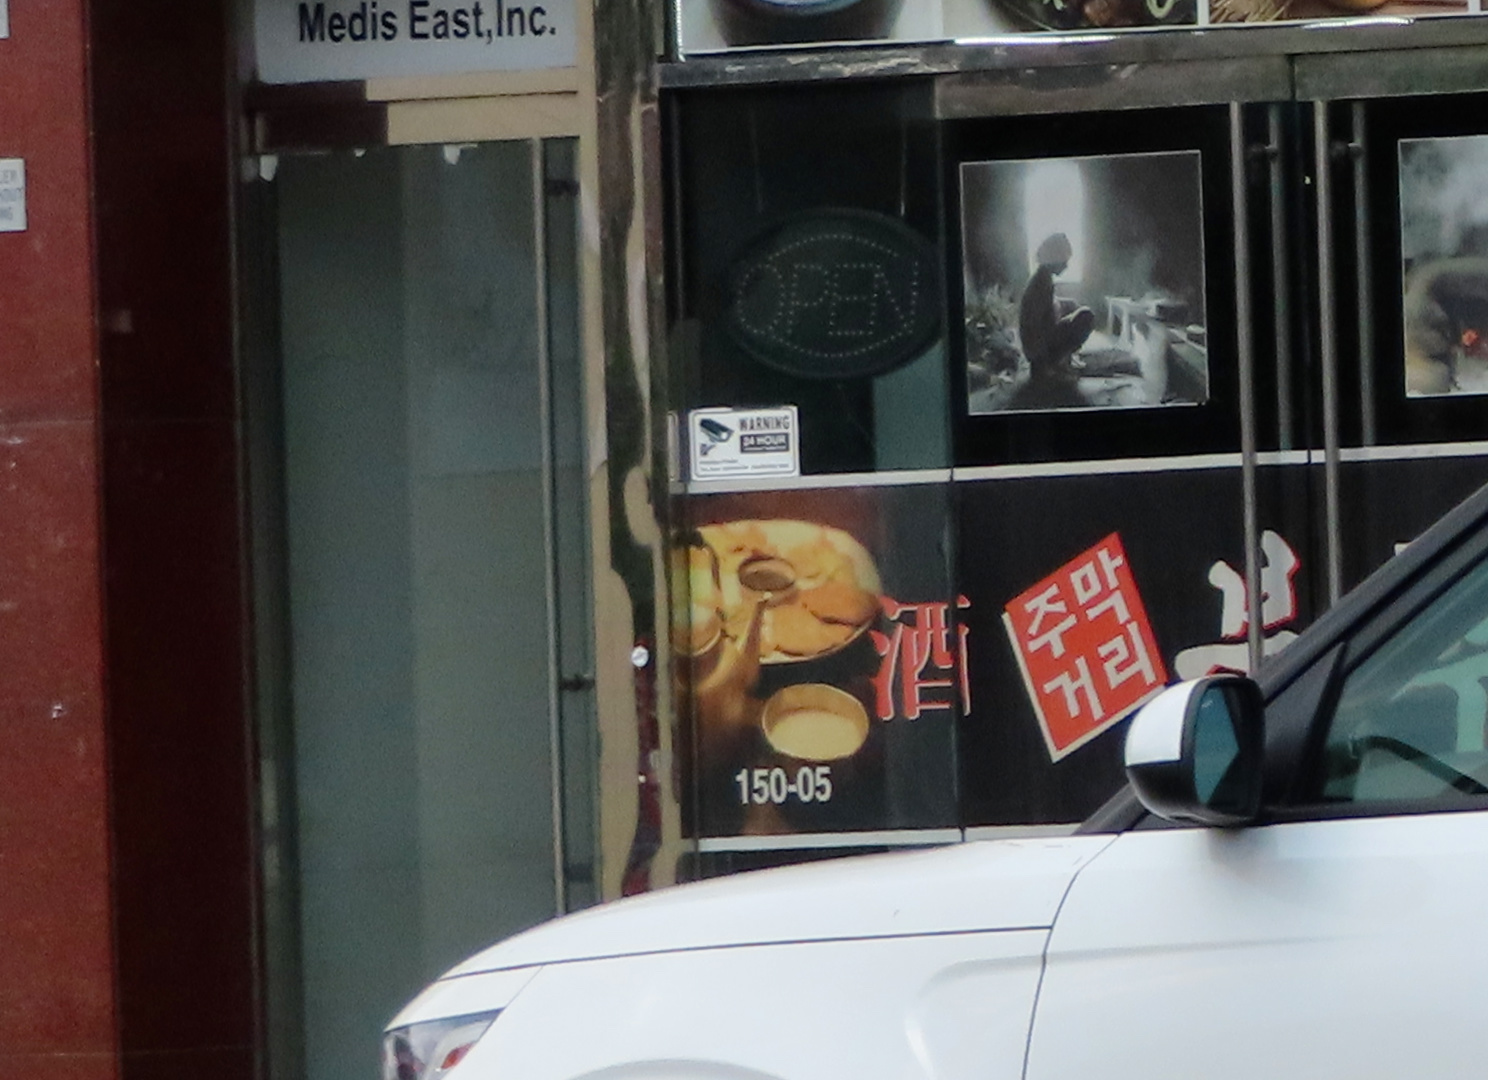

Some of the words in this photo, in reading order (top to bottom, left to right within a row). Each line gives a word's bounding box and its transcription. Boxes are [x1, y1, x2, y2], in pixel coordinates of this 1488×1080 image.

[299, 2, 398, 42] Medis
[409, 1, 556, 43] East,Inc.
[737, 262, 918, 337] OPEN
[740, 416, 790, 431] WARNING
[1023, 547, 1124, 660] 주막
[868, 594, 971, 720] 酒
[1043, 621, 1156, 722] 거리
[735, 765, 833, 806] 150-05
